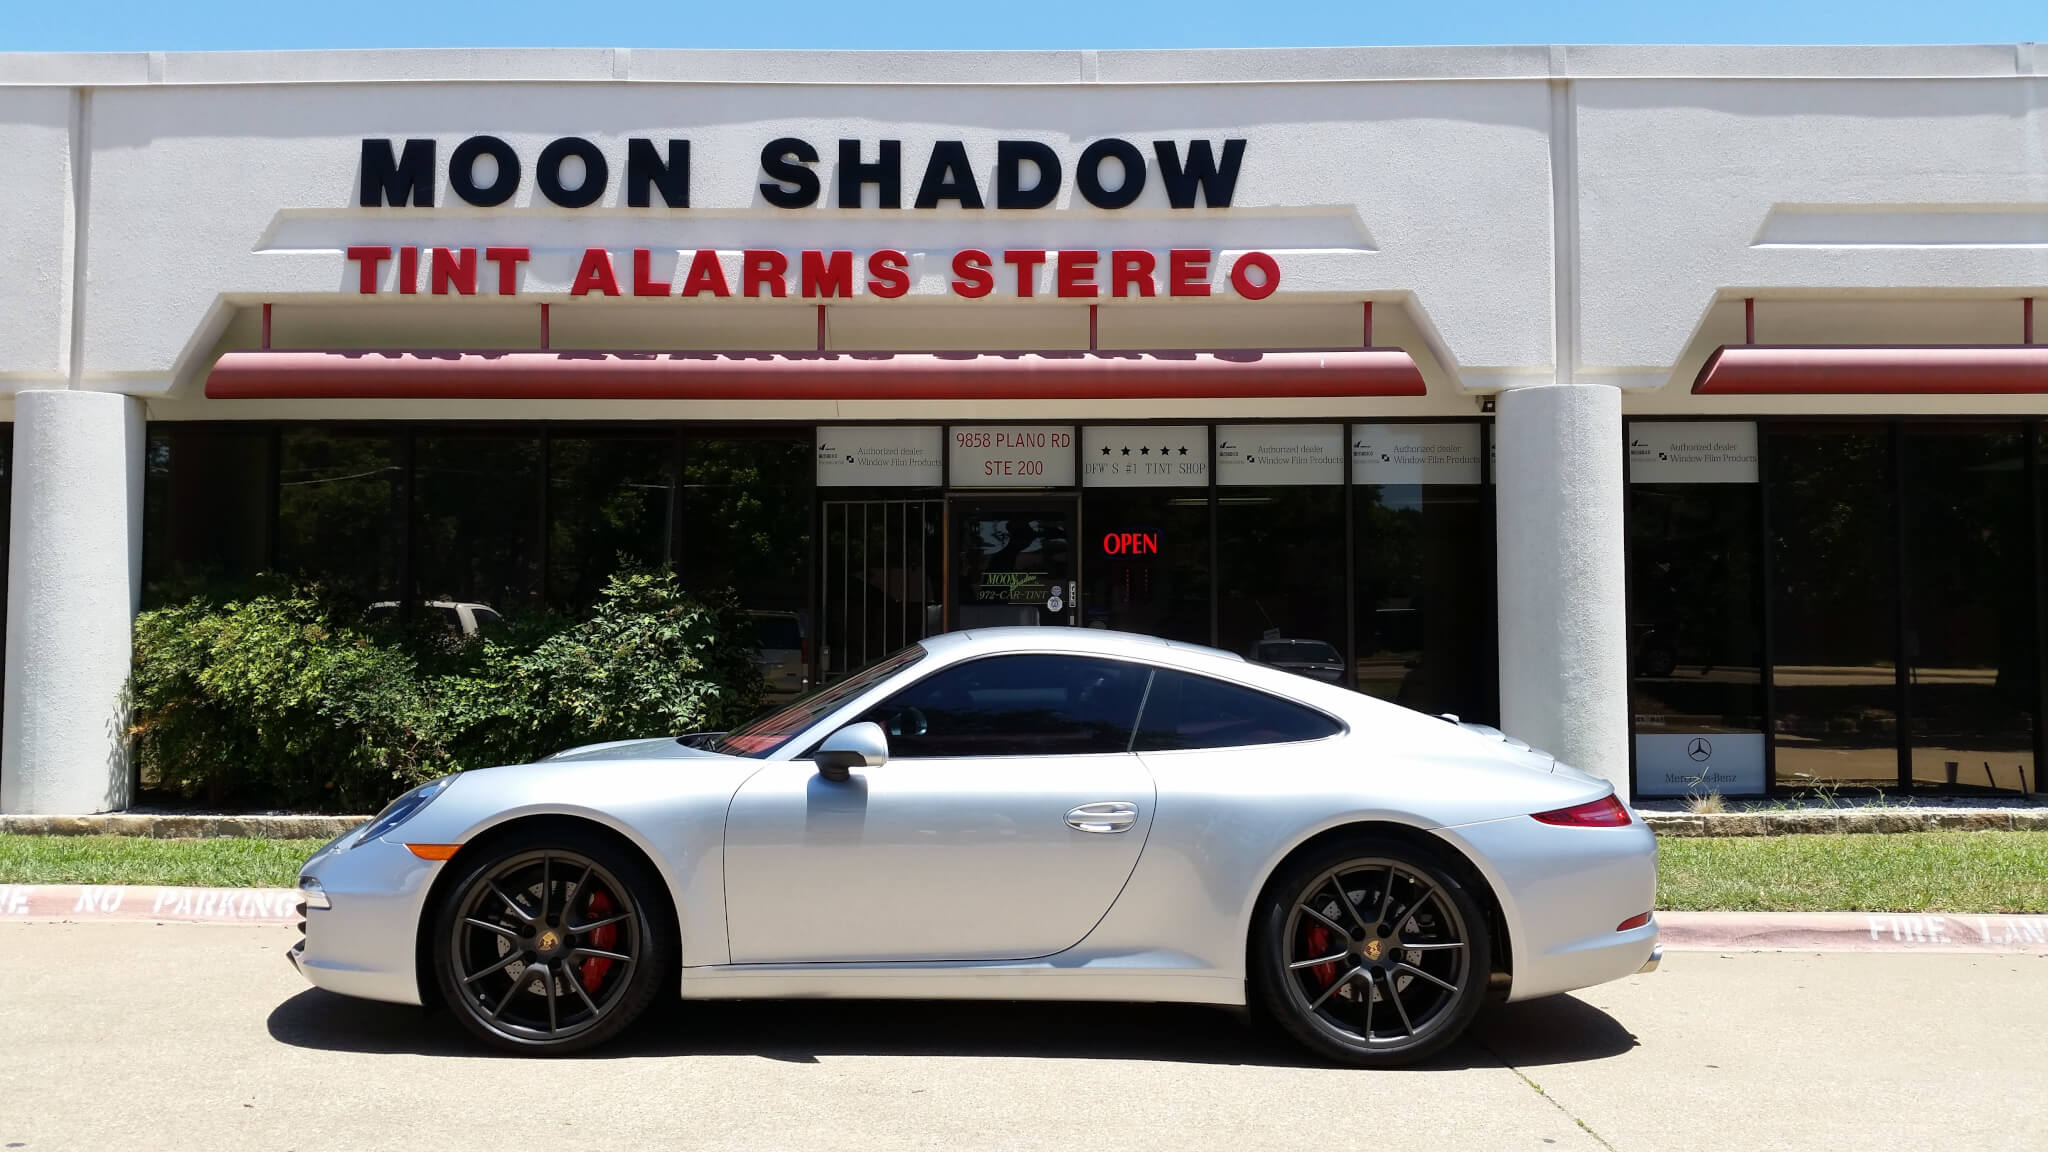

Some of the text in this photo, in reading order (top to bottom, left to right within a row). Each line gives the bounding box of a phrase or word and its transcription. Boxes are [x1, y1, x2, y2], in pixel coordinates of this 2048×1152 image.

[360, 135, 1247, 209] MOON SHADOW
[347, 245, 1281, 300] TINT ALARMS STEREO
[956, 433, 1071, 448] 9858 PLANO RD
[857, 447, 899, 455] Authorized
[1257, 444, 1298, 453] Authorized
[1393, 444, 1435, 453] Authorized
[1670, 443, 1736, 451] Authorized dealer
[857, 458, 942, 467] Window Film Products
[1258, 456, 1289, 464] Window
[1291, 456, 1307, 464] Film
[1310, 456, 1344, 464] Products
[1393, 455, 1480, 464] Window Film Products
[1670, 454, 1757, 463] Window Film Products
[984, 460, 1043, 476] STE 200
[1124, 463, 1137, 474] #1
[1145, 463, 1173, 474] TINT
[1178, 463, 1206, 474] SHOP
[1103, 533, 1157, 554] OPEN
[987, 574, 1017, 586] MOON
[979, 591, 1048, 600] 972-CAR-TINT
[74, 887, 124, 913] NO
[152, 888, 297, 918] PARKING
[1865, 915, 1950, 943] FIRE
